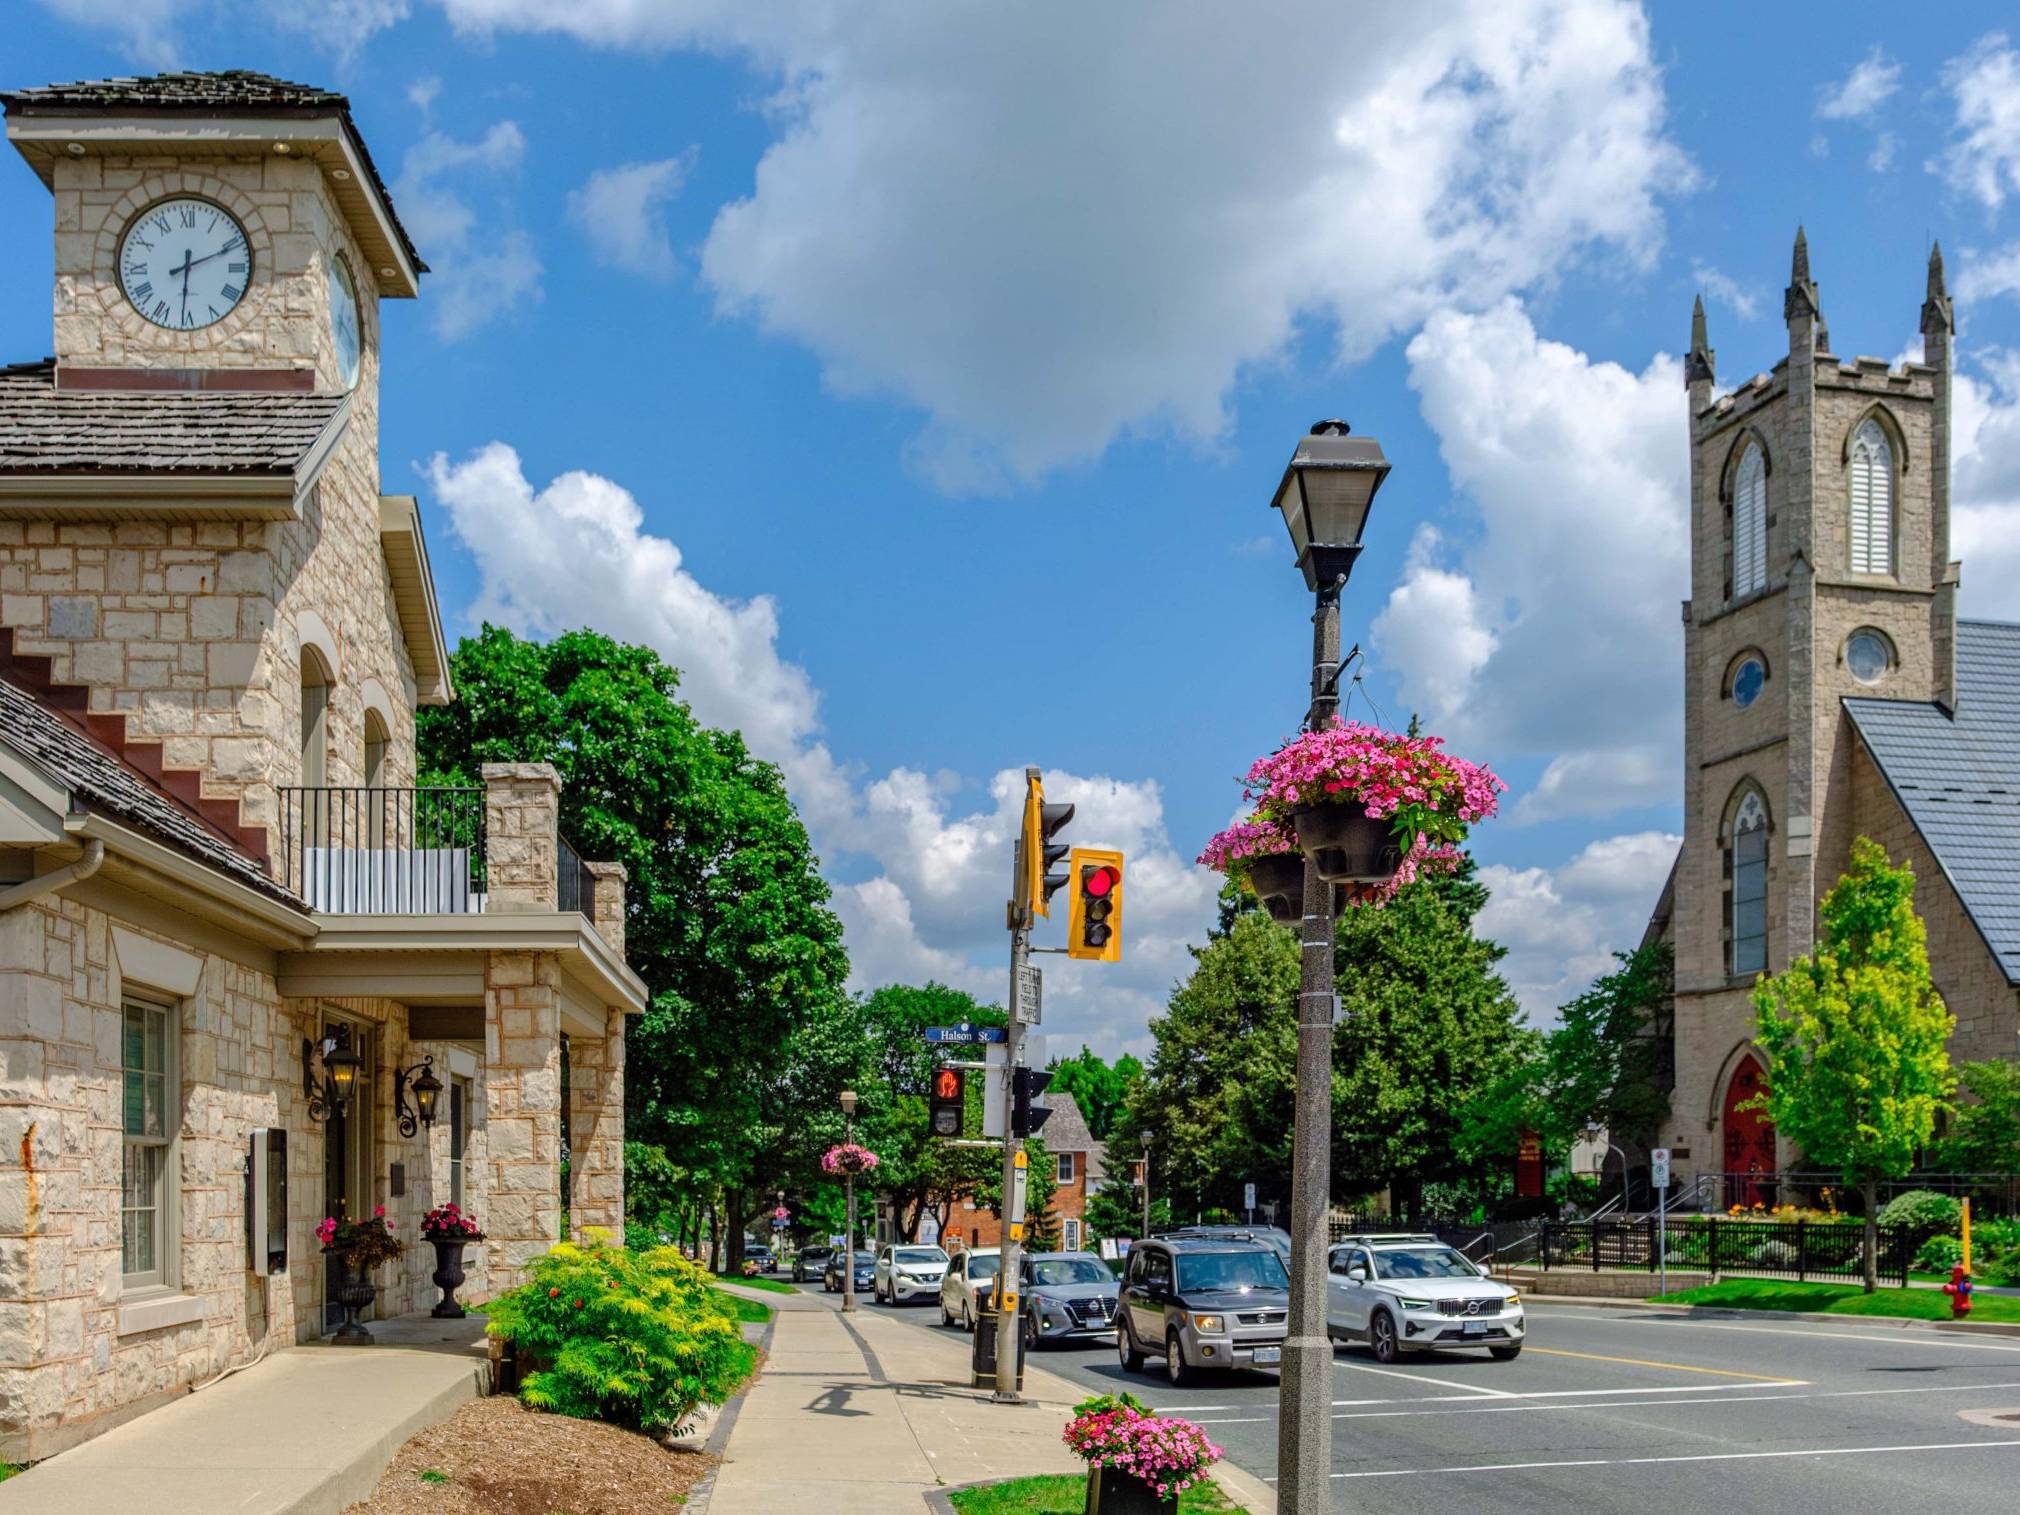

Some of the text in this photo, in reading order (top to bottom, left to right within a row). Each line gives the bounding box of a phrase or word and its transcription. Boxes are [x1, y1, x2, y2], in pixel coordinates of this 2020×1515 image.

[154, 215, 171, 237] XI
[180, 209, 195, 228] XII
[135, 234, 154, 252] X
[130, 262, 148, 275] IX
[228, 263, 245, 273] III
[134, 281, 153, 305] VIII
[153, 300, 171, 321] VII
[208, 304, 220, 320] V
[1021, 1006, 1037, 1018] TRAFFIC
[941, 1030, 972, 1040] Halson
